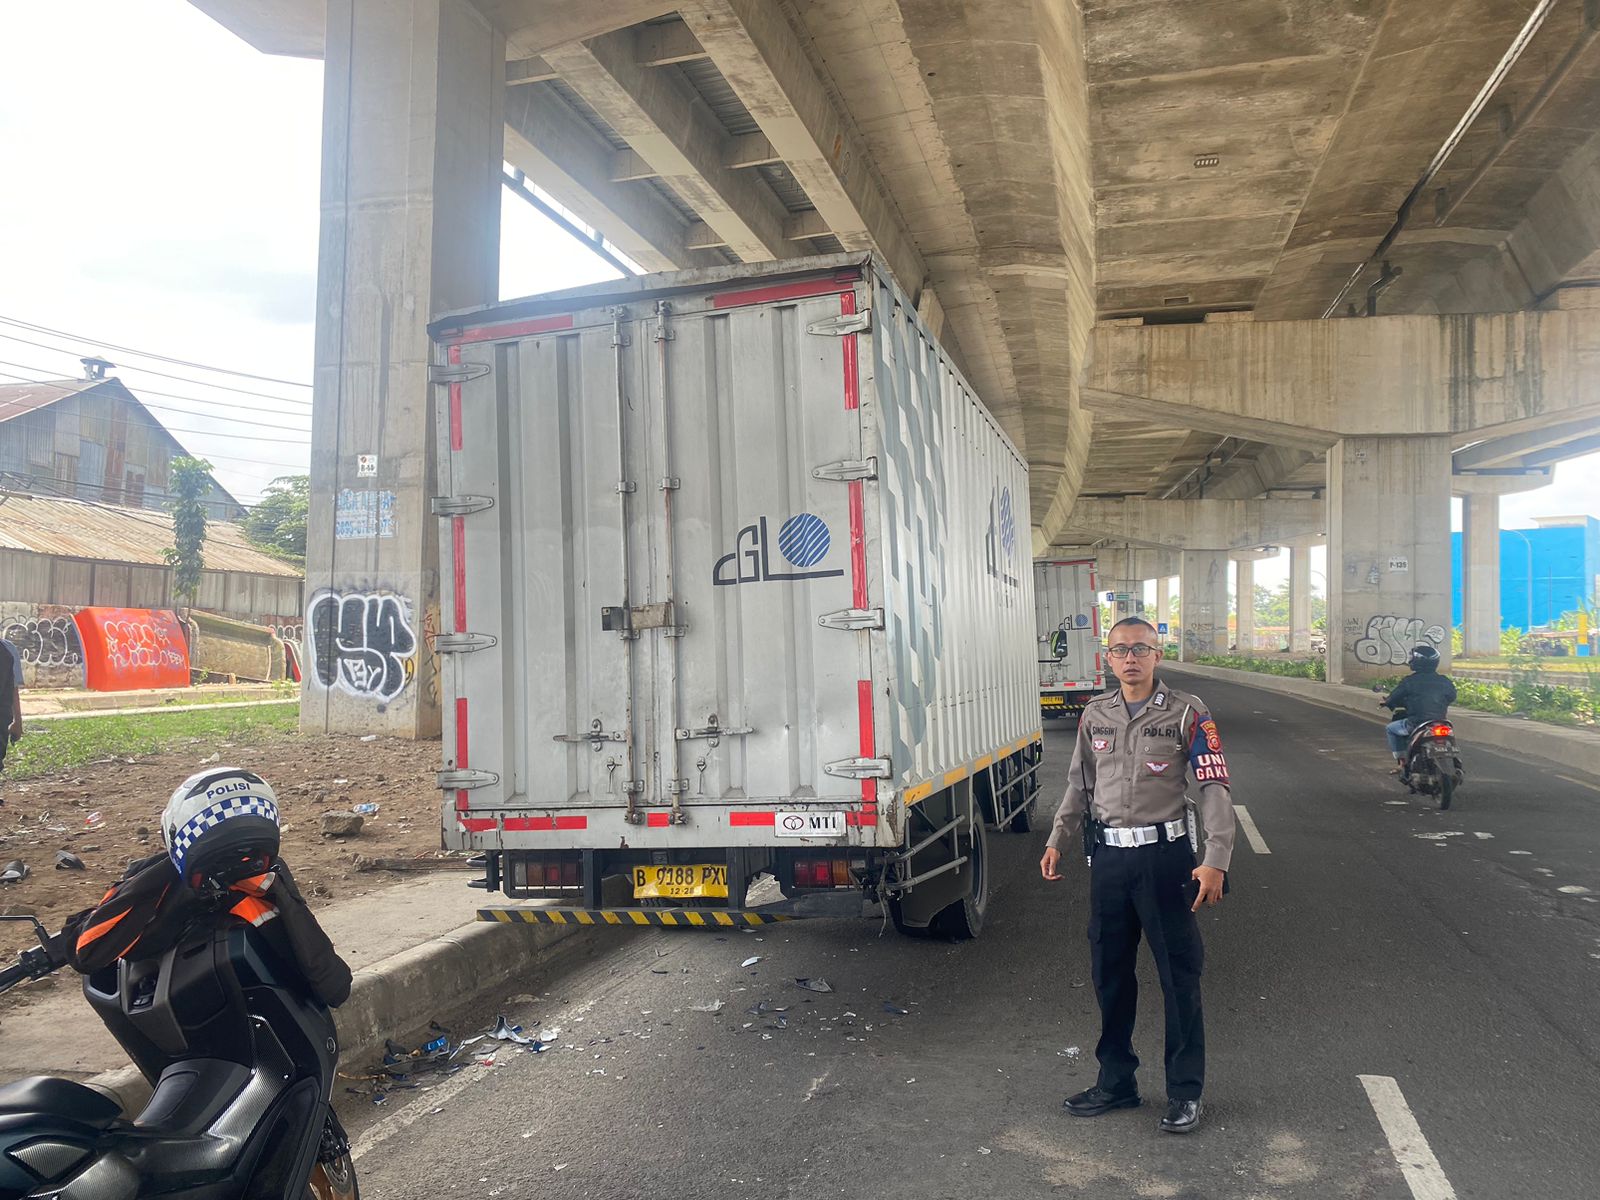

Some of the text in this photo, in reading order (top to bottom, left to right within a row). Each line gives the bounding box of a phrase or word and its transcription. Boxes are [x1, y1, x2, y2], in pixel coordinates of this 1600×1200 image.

[1143, 727, 1176, 738] POLRI
[206, 782, 251, 799] POLISI
[809, 816, 837, 829] MTI
[636, 869, 646, 887] B
[656, 867, 694, 886] 9188
